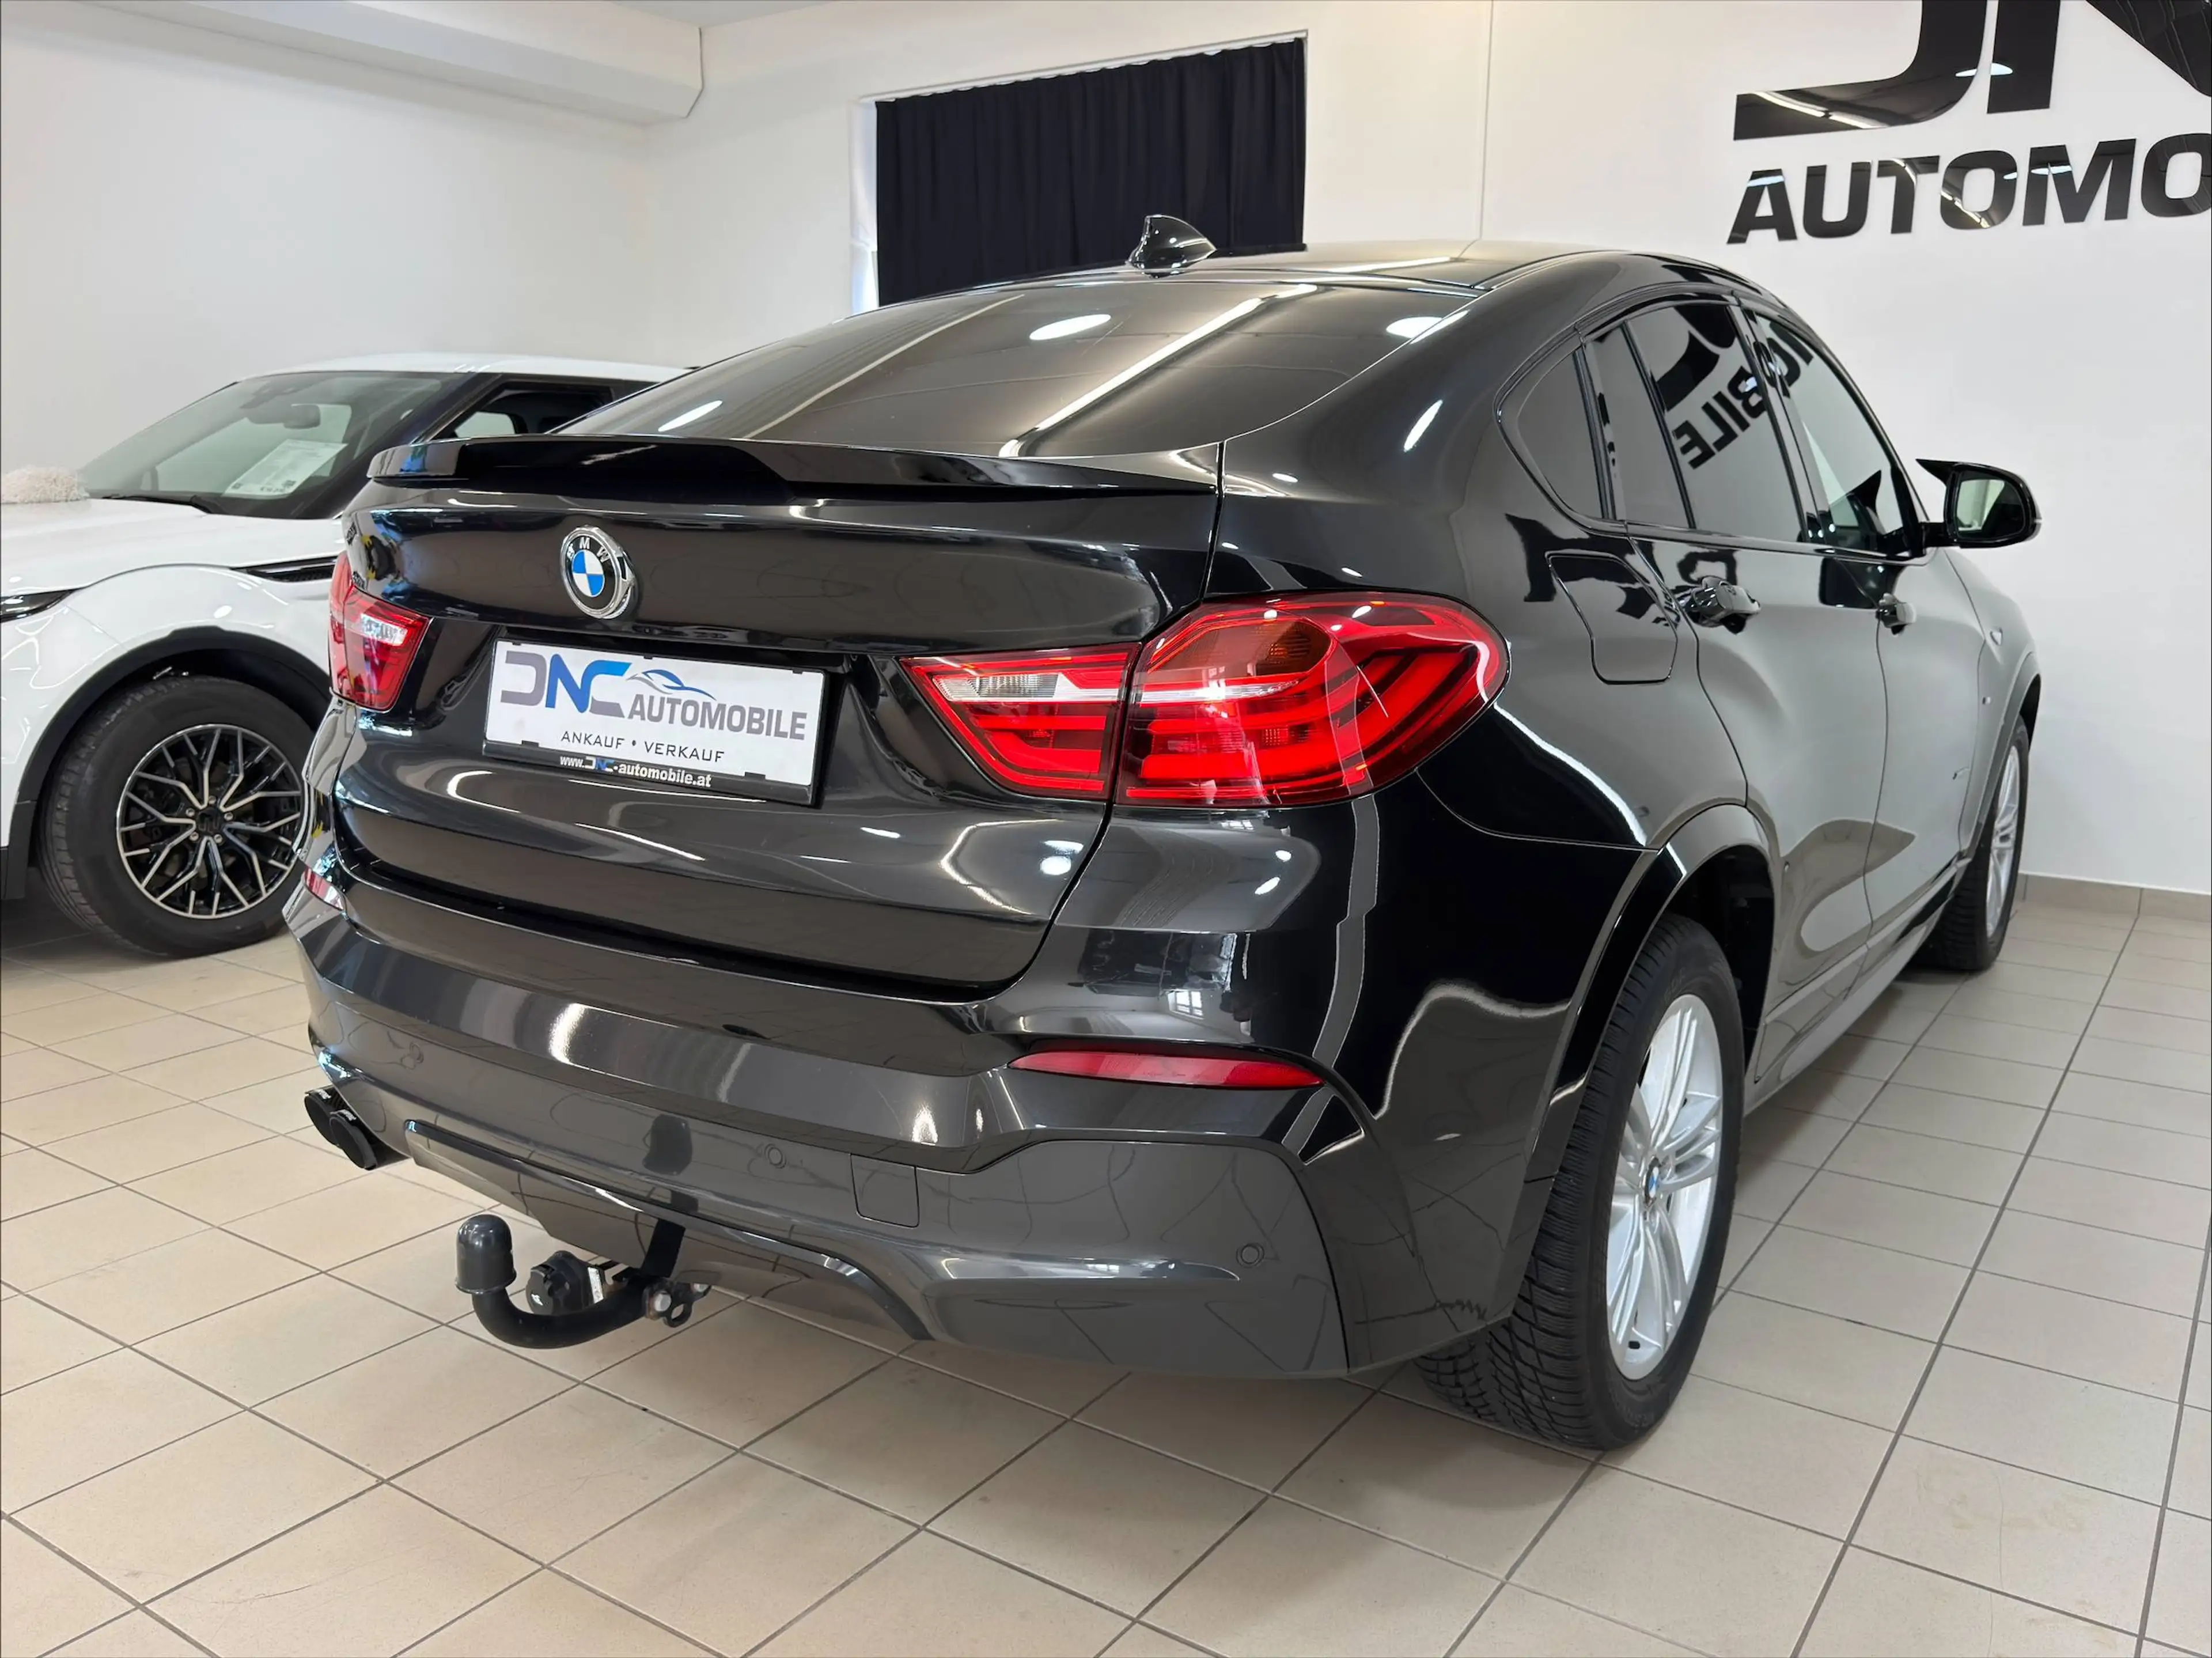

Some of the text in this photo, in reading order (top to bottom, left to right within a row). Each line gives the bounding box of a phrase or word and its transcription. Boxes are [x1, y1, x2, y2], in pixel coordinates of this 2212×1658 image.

[500, 650, 632, 718] DNC
[628, 694, 807, 740] AUTOMOBILE
[560, 730, 725, 763] ANKAUF VERKAUF
